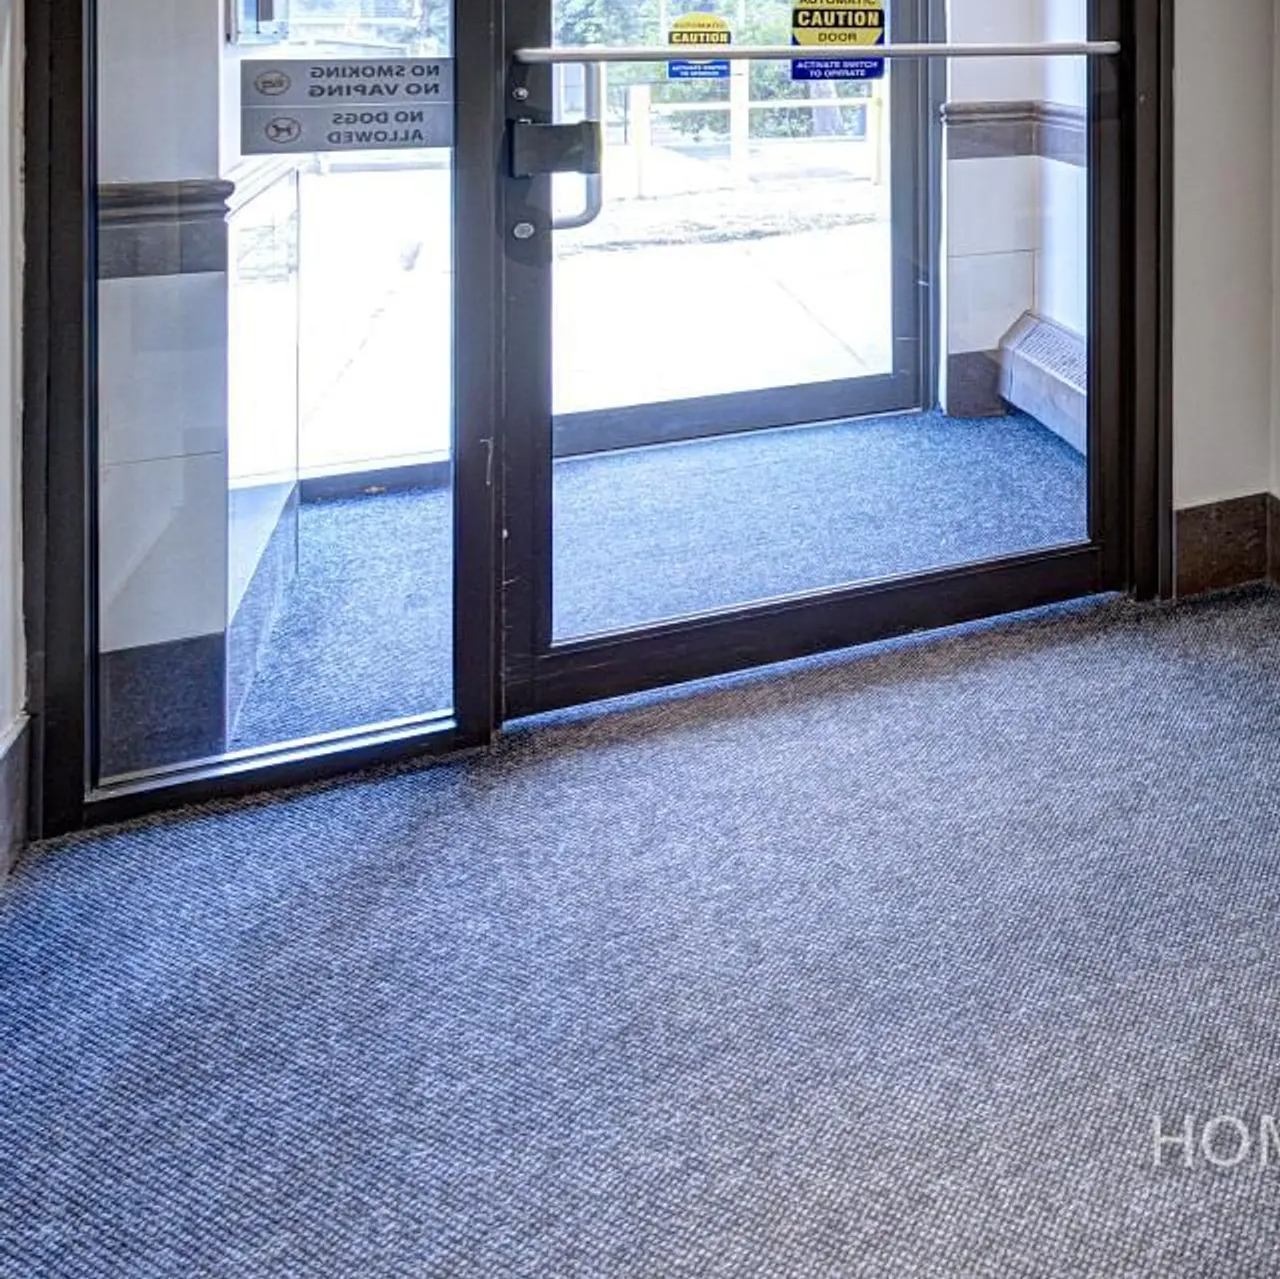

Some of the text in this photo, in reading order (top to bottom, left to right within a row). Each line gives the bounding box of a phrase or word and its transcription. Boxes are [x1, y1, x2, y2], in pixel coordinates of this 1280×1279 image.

[798, 11, 879, 27] CAUTION
[672, 33, 728, 42] CAUTION
[818, 33, 857, 43] DOOR
[797, 61, 839, 69] ACTIVATE
[809, 69, 822, 77] TO
